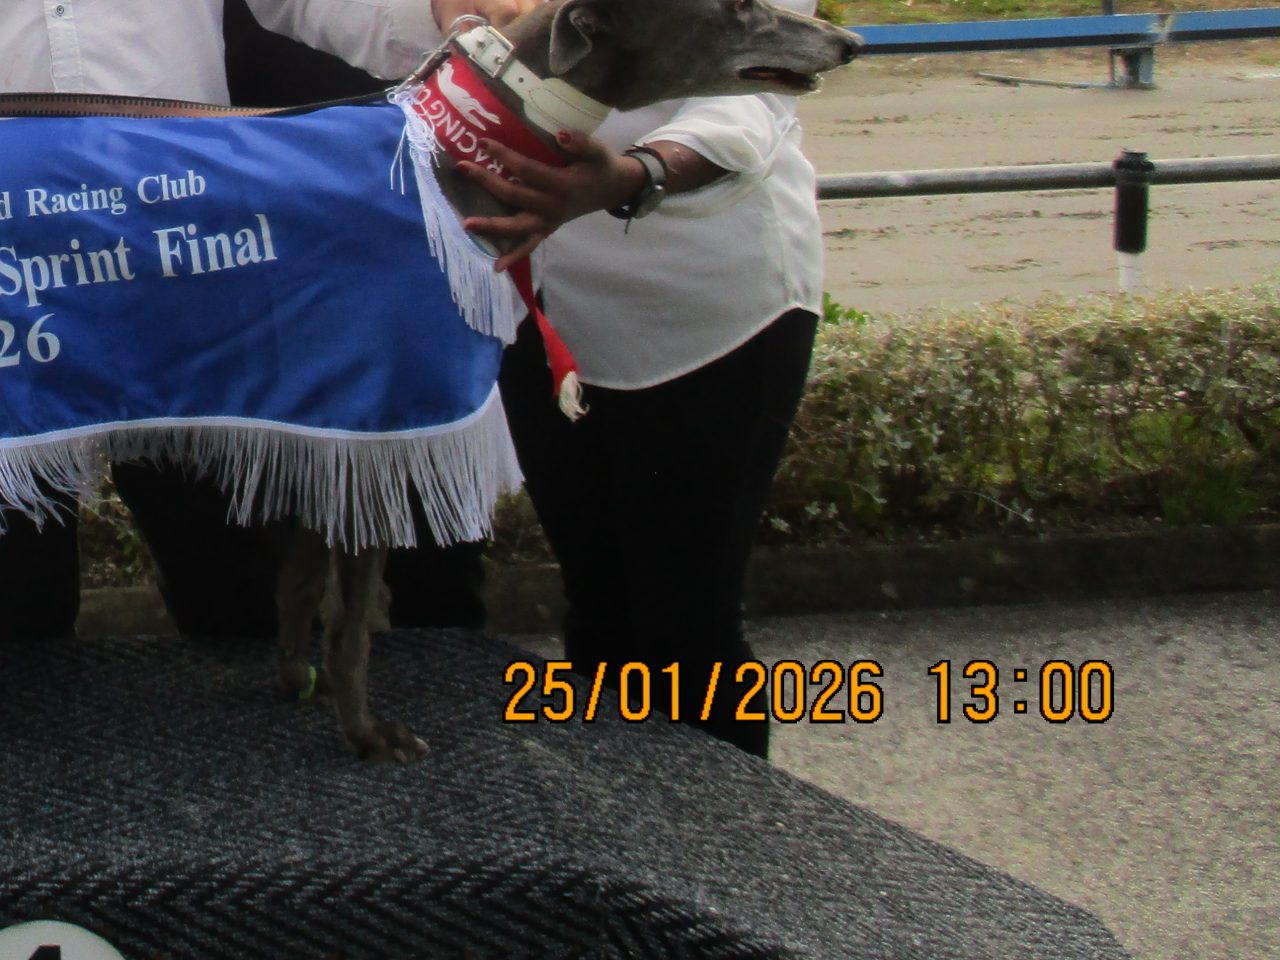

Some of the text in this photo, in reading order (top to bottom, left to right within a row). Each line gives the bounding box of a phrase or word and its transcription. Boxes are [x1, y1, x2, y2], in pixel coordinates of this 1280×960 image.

[26, 182, 124, 215] Racing
[137, 169, 206, 205] Club
[153, 213, 278, 278] Final
